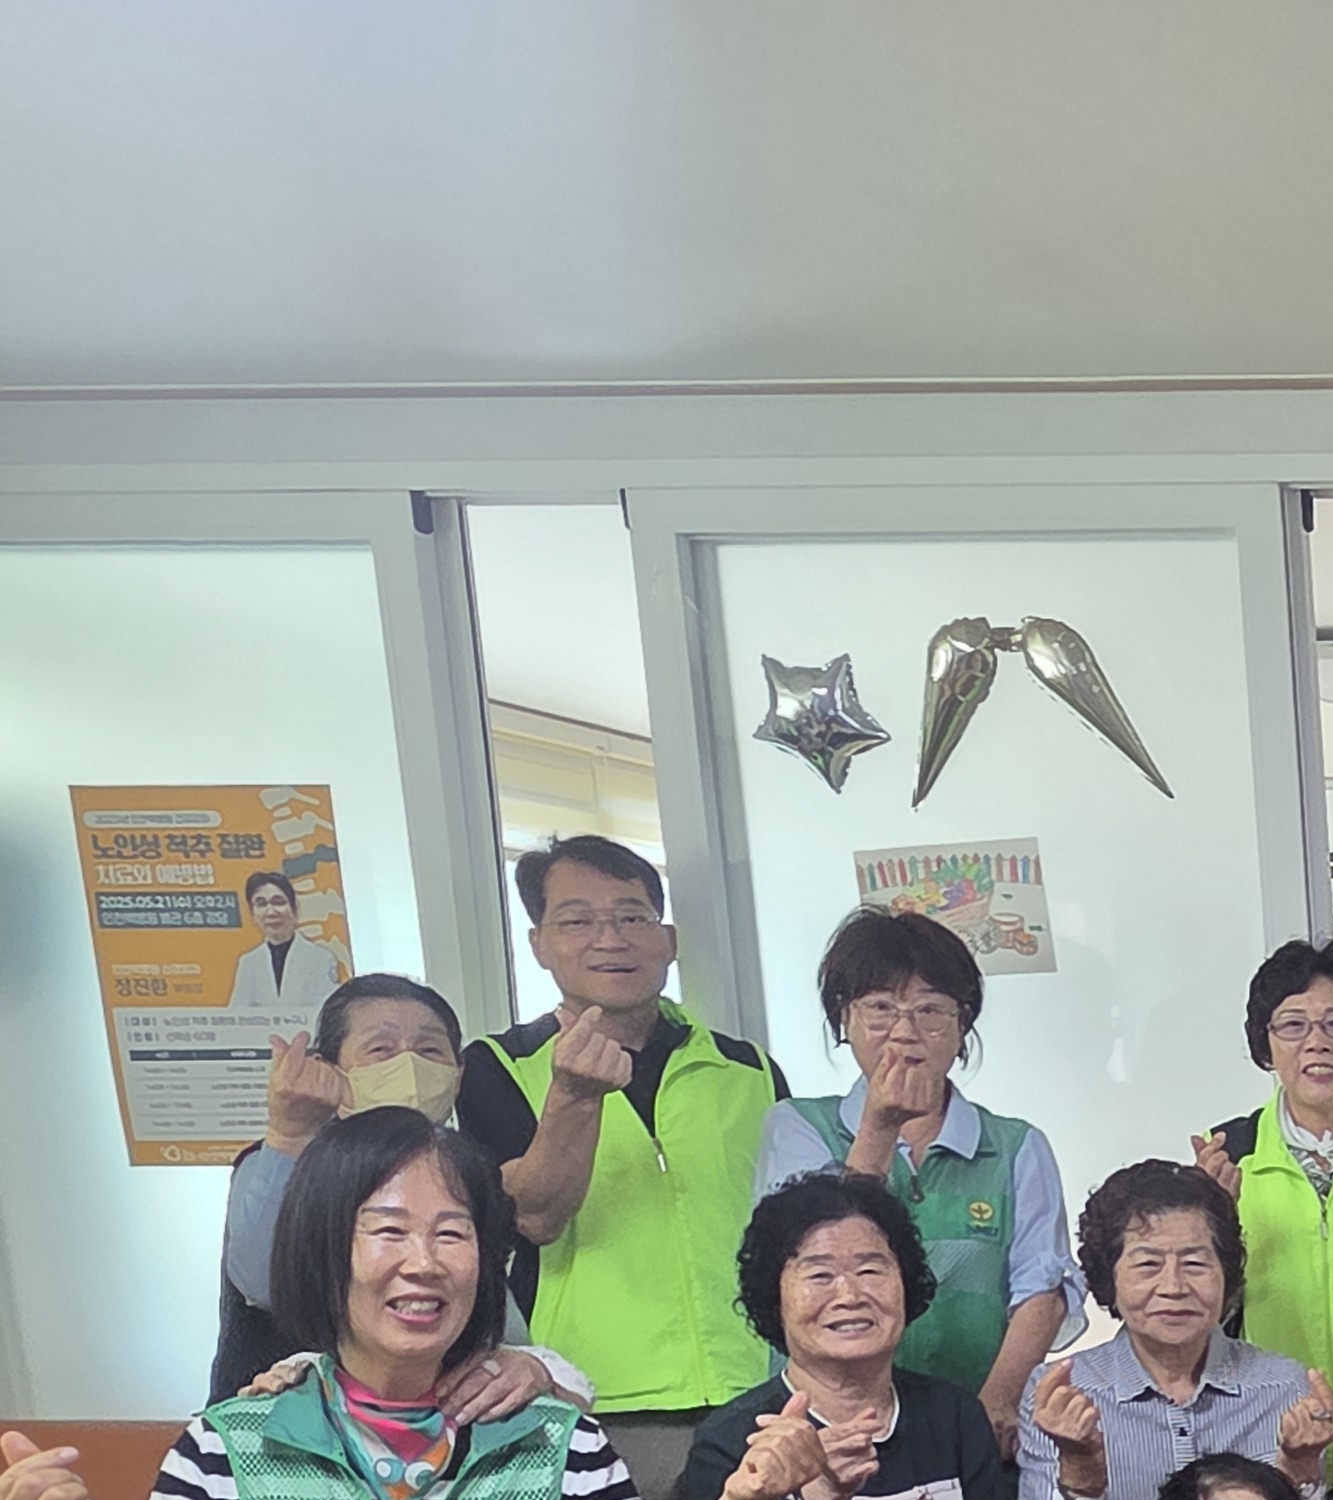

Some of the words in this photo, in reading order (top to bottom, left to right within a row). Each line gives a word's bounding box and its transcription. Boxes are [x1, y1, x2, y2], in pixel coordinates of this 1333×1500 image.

[91, 833, 162, 860] 노인성
[164, 833, 214, 859] 척추
[94, 863, 153, 885] 치료와
